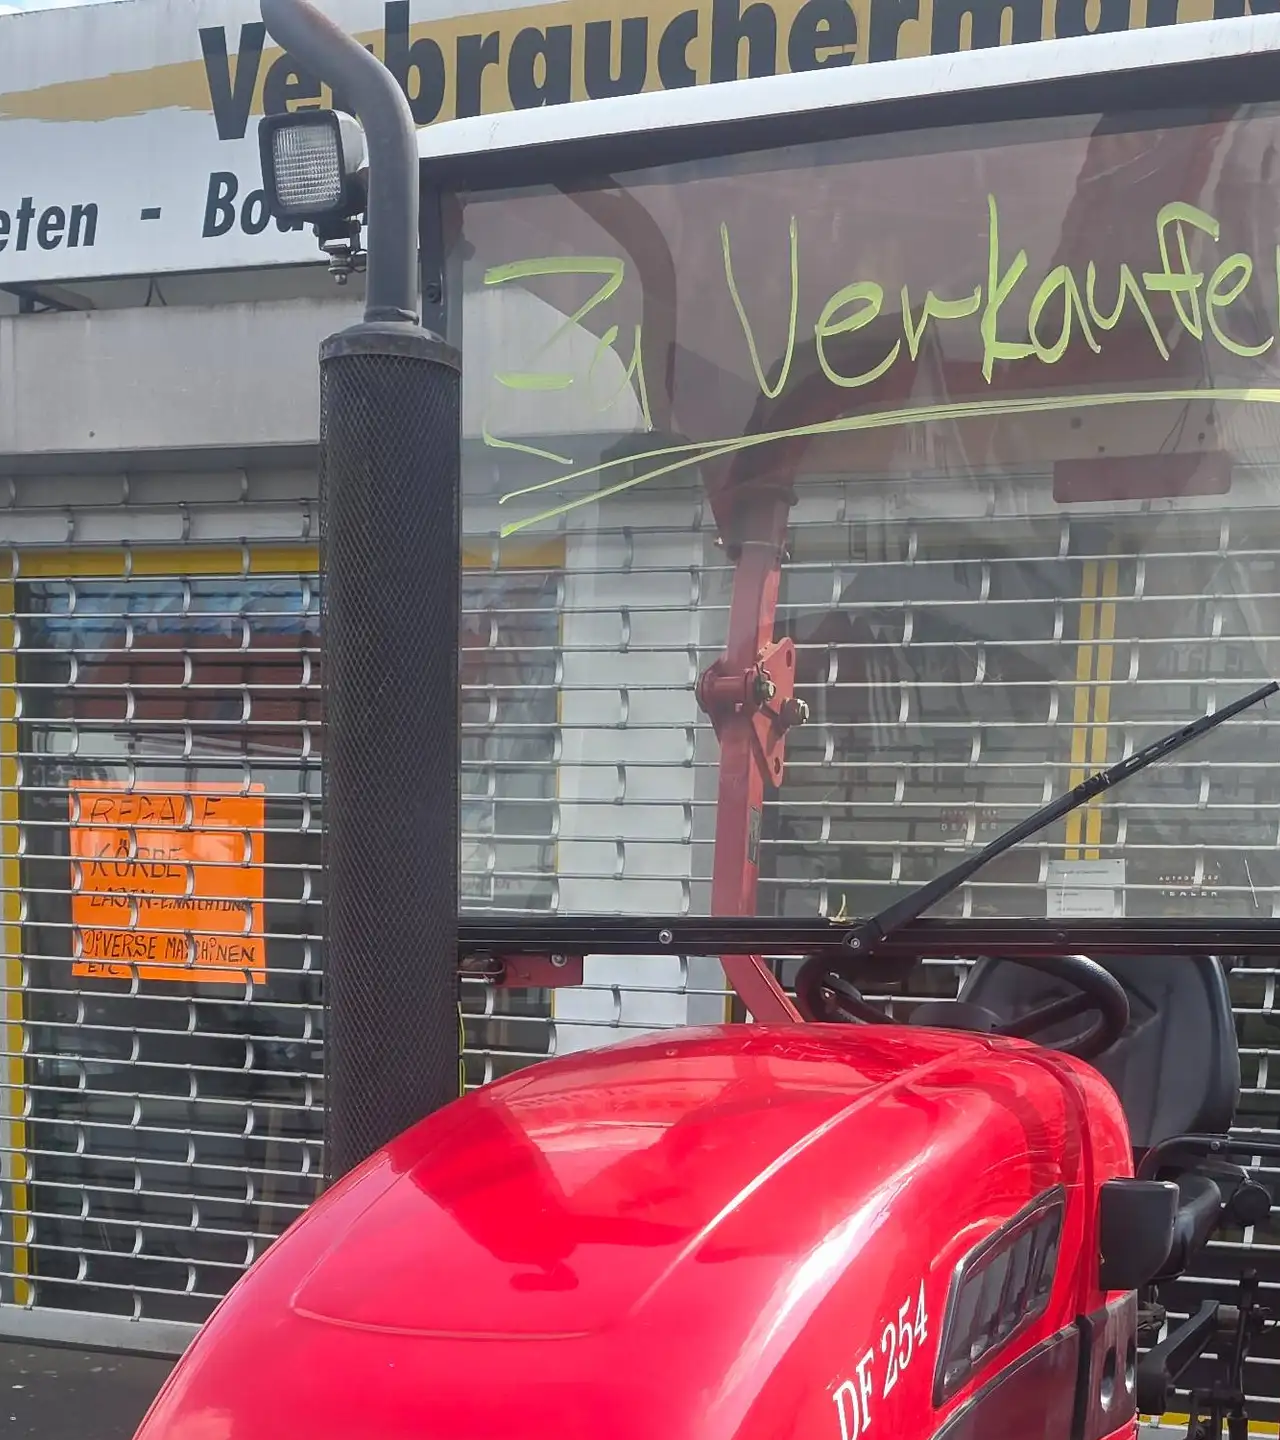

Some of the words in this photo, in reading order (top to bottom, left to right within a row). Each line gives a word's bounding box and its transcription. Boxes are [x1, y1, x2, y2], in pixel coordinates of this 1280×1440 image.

[941, 822, 997, 831] DEAER
[91, 838, 183, 878] KÖRBE
[881, 1278, 928, 1399] 254
